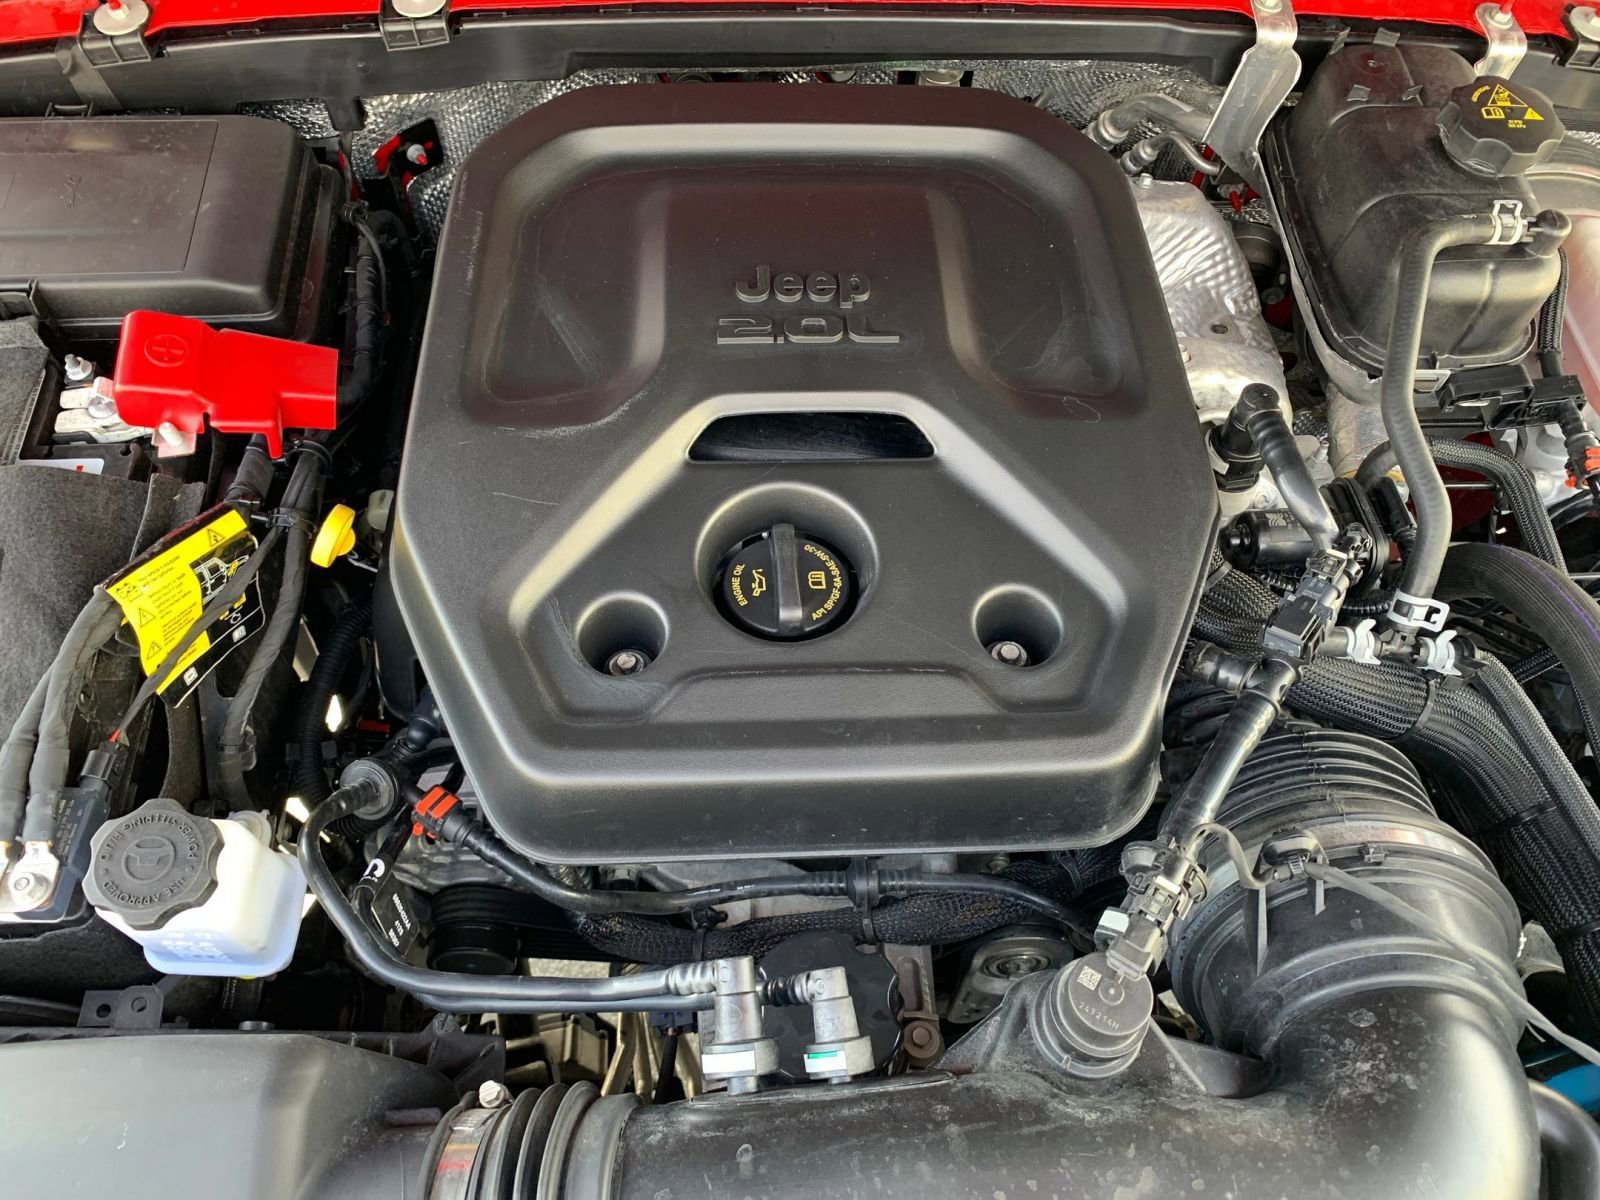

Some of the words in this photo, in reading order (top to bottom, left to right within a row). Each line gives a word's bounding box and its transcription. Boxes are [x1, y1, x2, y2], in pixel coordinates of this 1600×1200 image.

[735, 264, 871, 308] Jeep
[717, 313, 900, 344] 2.0L
[733, 563, 746, 576] OIL
[731, 576, 749, 607] ENGINE
[811, 607, 828, 621] API
[122, 813, 178, 832] STEERING
[100, 831, 124, 861] FLUID
[177, 822, 200, 860] POWER
[102, 880, 160, 905] APPROVED
[165, 877, 187, 897] USE
